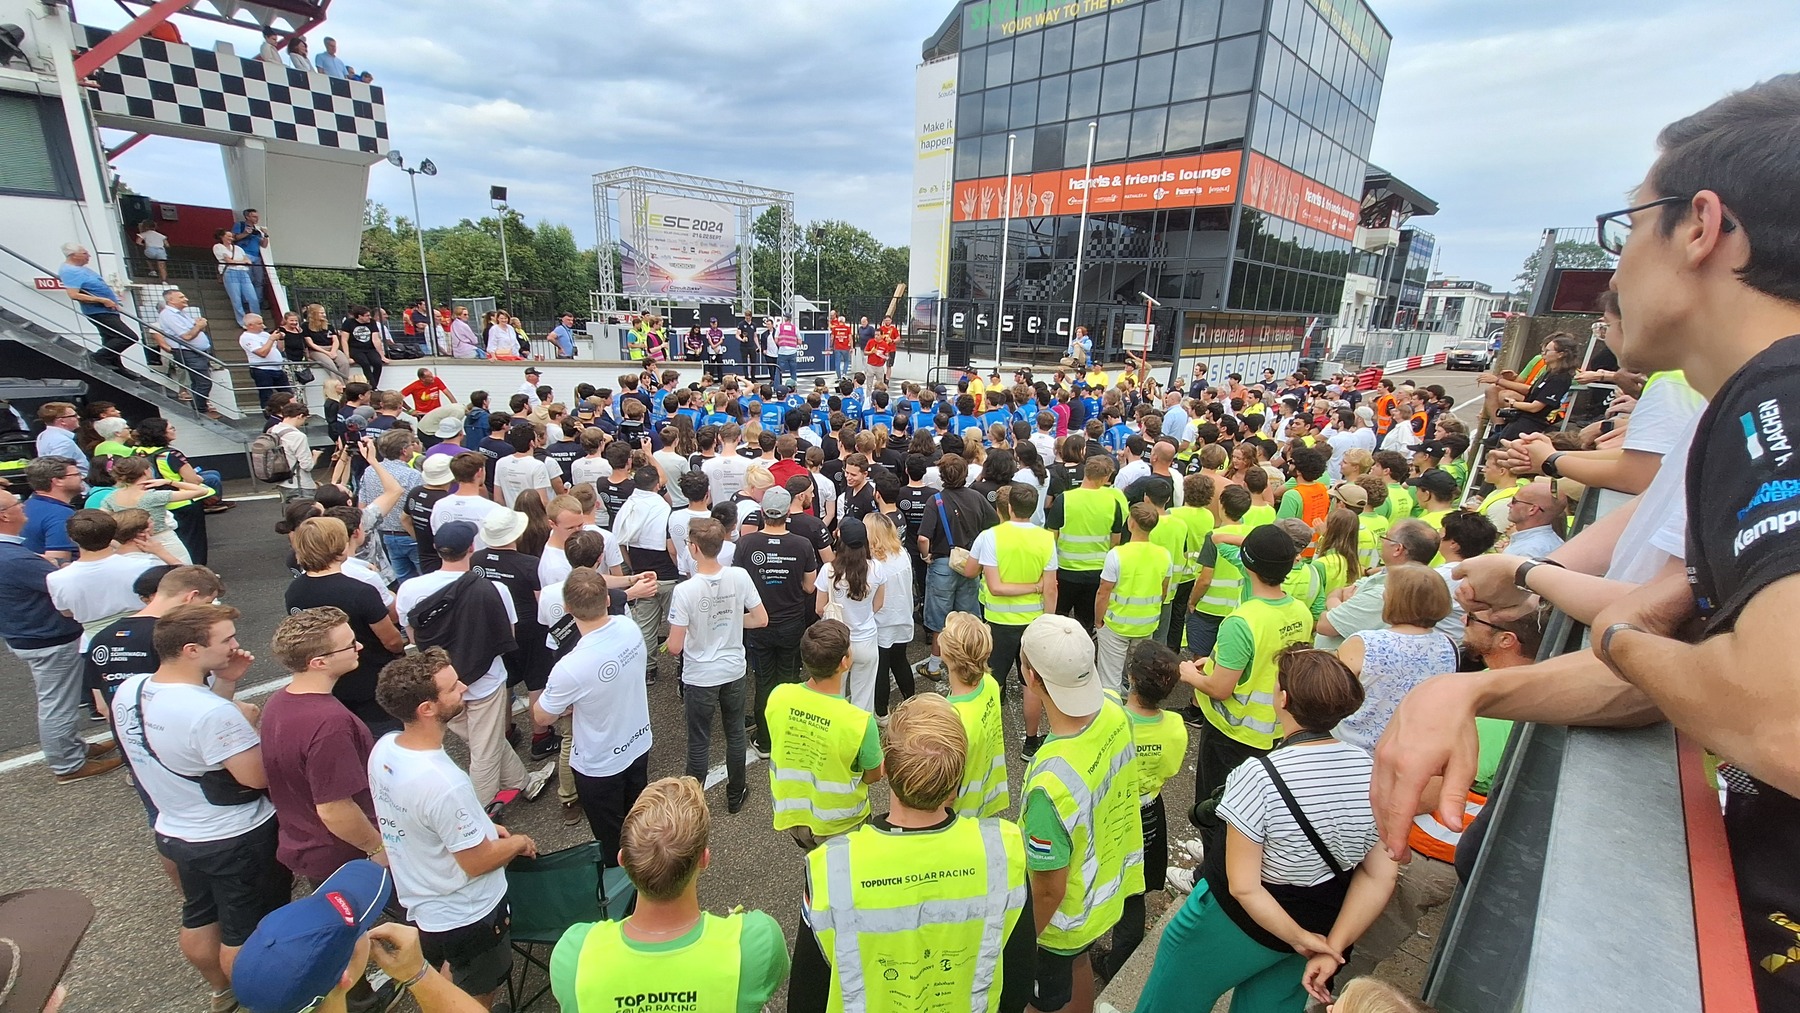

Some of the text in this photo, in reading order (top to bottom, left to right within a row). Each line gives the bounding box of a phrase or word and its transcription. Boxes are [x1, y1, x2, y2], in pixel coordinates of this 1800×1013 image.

[1001, 0, 1107, 35] YOUR WAY TO THE
[923, 119, 953, 134] Make it
[921, 136, 954, 151] happen.
[1112, 175, 1122, 187] &
[1125, 170, 1175, 186] friends
[1179, 166, 1232, 181] lounge
[692, 219, 724, 233] 2024
[693, 310, 700, 319] 2
[730, 305, 735, 315] 1
[1210, 324, 1246, 344] remeha
[1758, 399, 1792, 452] AACHEN
[1734, 509, 1800, 557] Kemp
[789, 707, 831, 727] TOP DUTCH
[808, 720, 829, 733] RACING
[1136, 744, 1162, 752] DUTCH
[861, 868, 976, 888] TOPDUTCH SOLAR RACING
[614, 991, 697, 1008] TOP DUTCH
[655, 1004, 697, 1013] RACING
